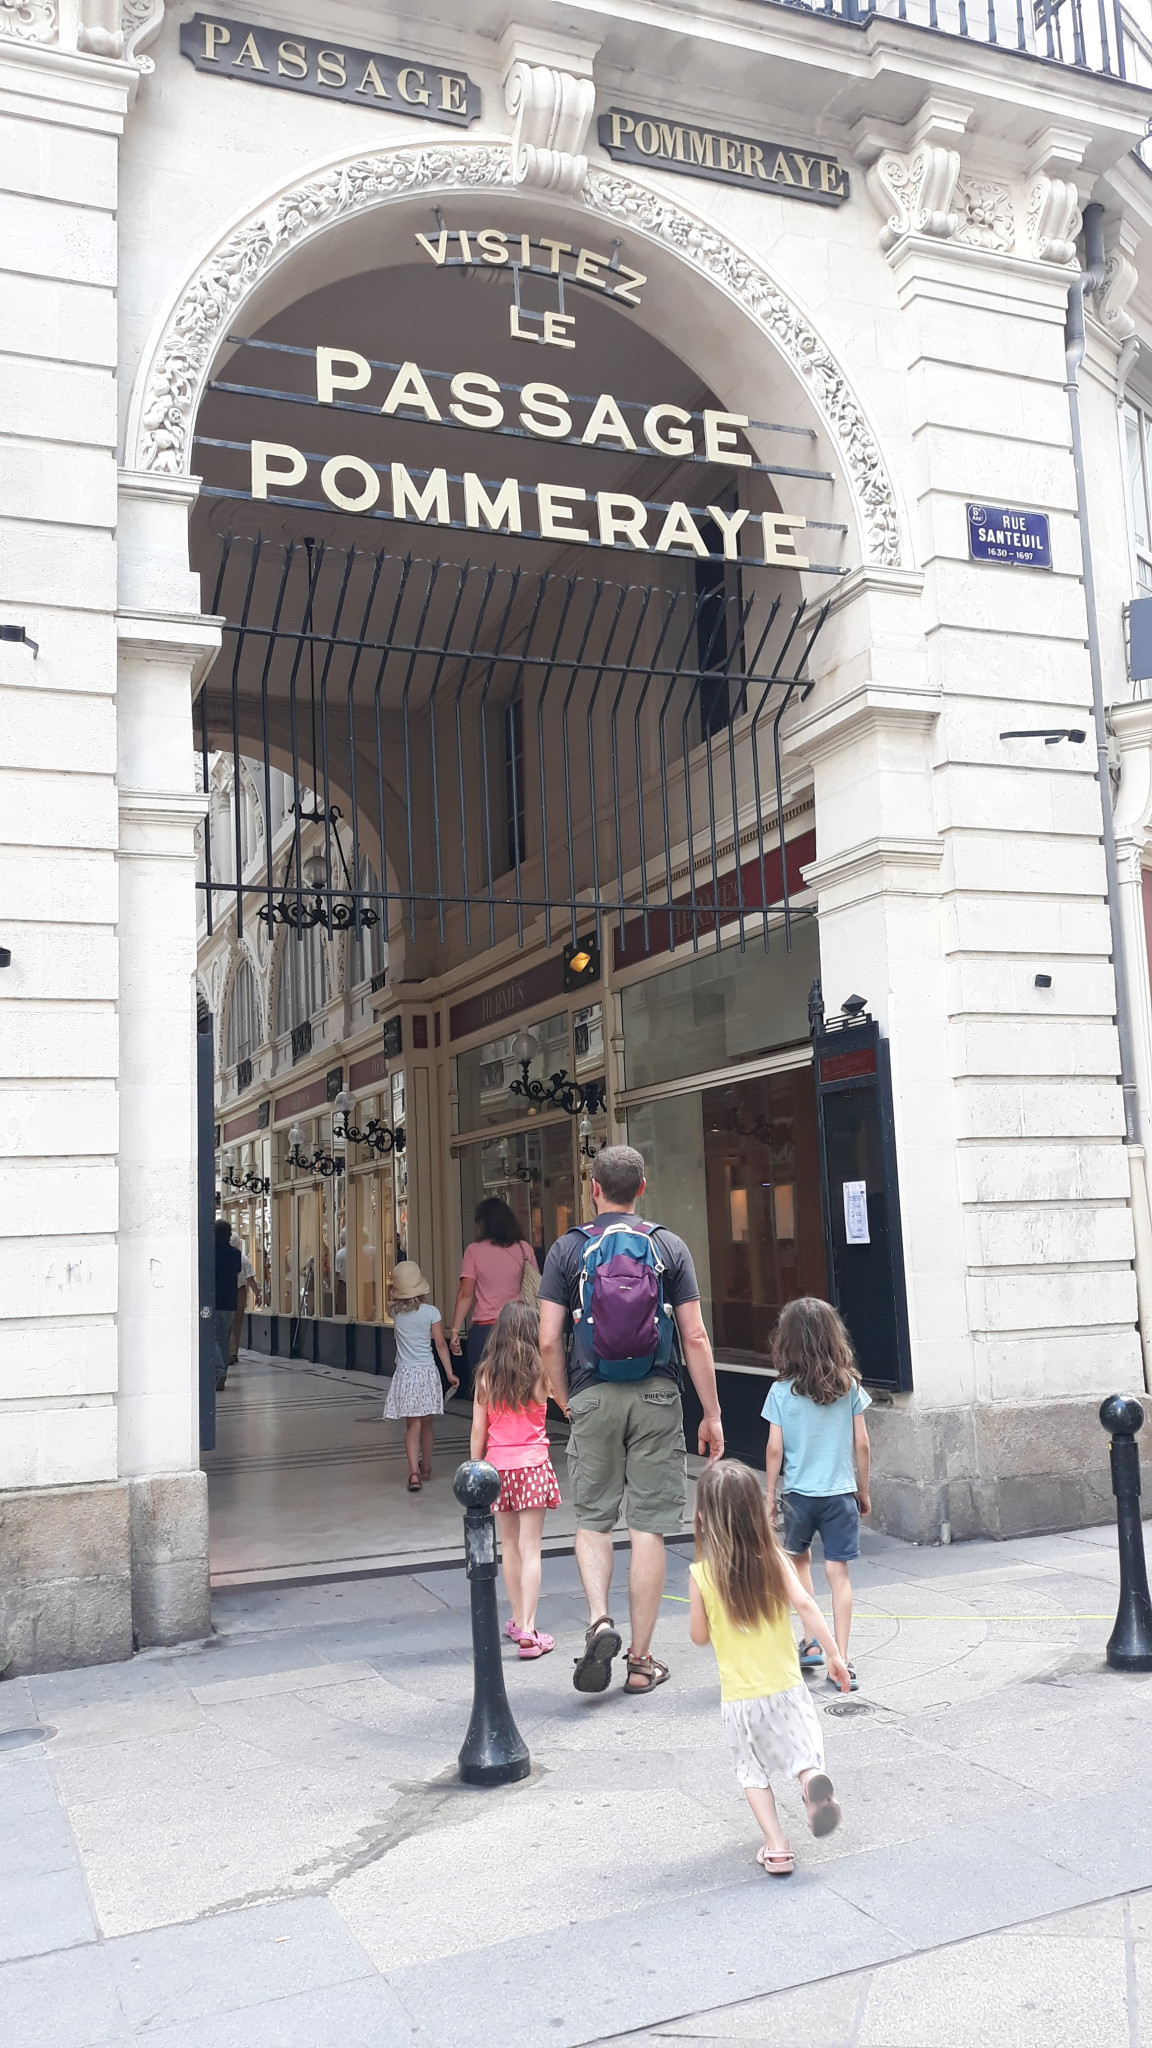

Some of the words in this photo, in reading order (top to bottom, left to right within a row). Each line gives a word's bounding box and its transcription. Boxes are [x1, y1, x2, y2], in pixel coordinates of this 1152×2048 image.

[200, 21, 468, 116] PASSAGE
[608, 112, 845, 196] POMMERAYE
[415, 229, 648, 305] VISITEZ
[510, 304, 576, 349] LE
[316, 345, 753, 468] PASSAGE
[251, 439, 810, 569] POMMERAYE
[978, 527, 1044, 550] SANTEUIL
[1002, 515, 1027, 531] RUE
[988, 547, 1007, 557] 1630
[1016, 551, 1033, 560] 1697
